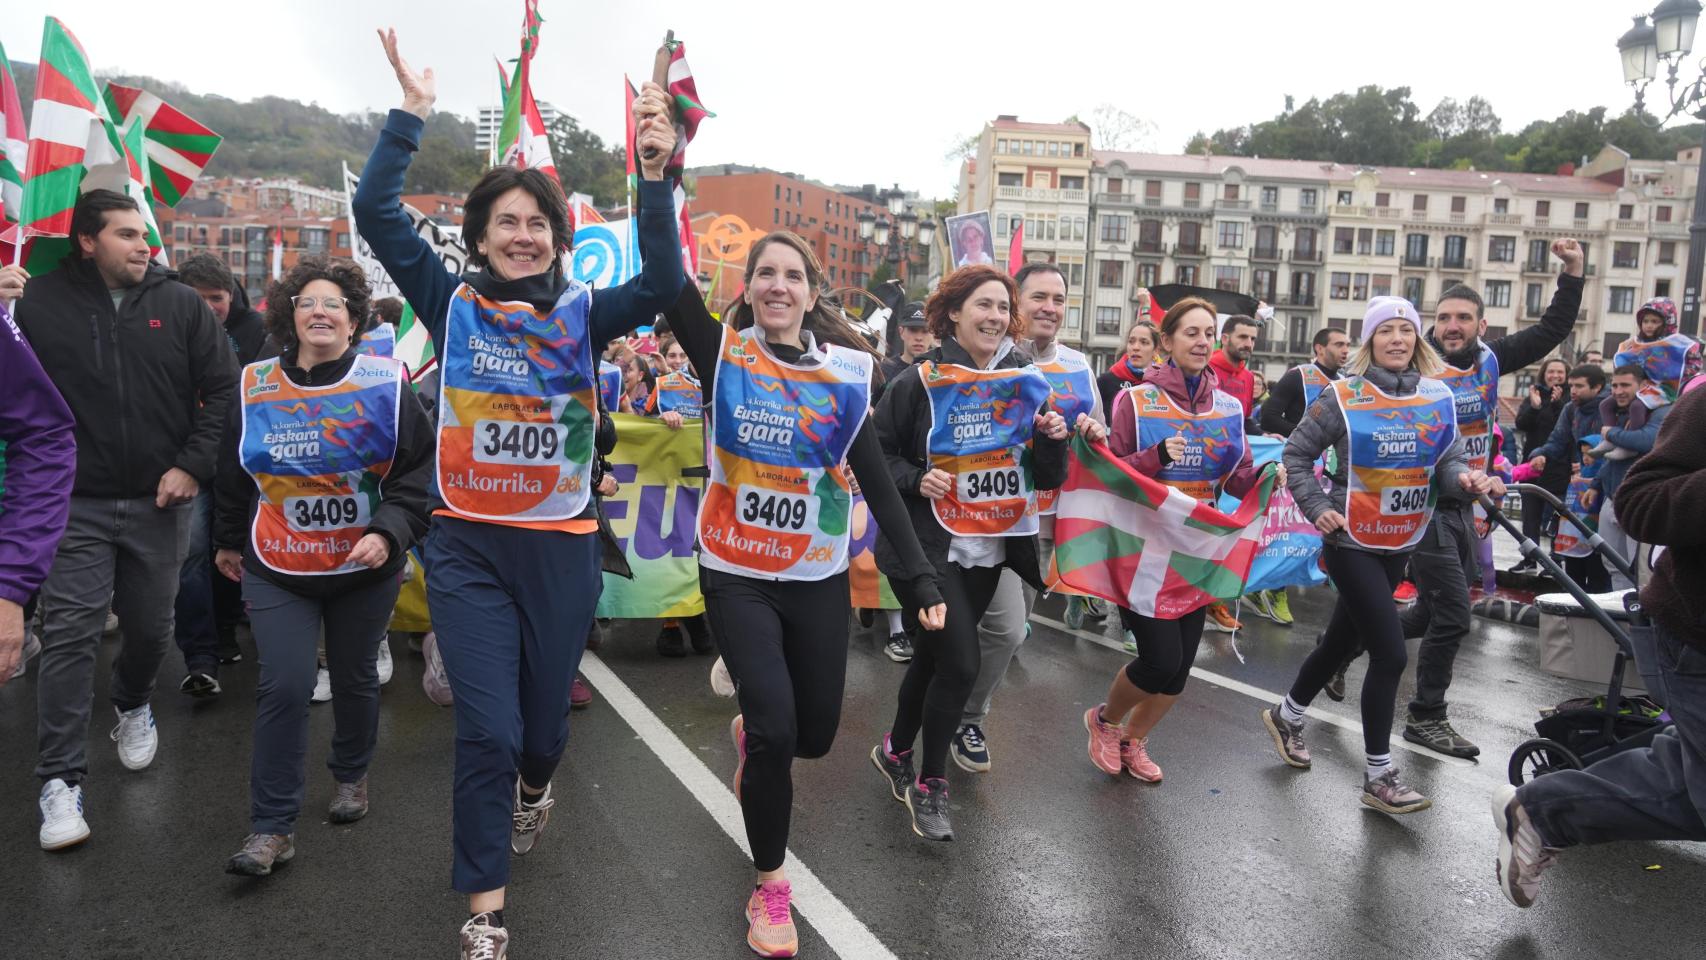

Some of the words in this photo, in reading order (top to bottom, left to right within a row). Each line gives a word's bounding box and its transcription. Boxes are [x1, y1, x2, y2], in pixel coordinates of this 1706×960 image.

[366, 369, 394, 378] eitb
[472, 352, 529, 375] gara
[733, 405, 795, 428] Euskara
[947, 411, 991, 425] Euskara
[263, 430, 319, 443] Euskara
[484, 422, 559, 459] 3409
[737, 422, 794, 446] gara
[953, 422, 992, 443] gara
[1372, 430, 1416, 441] Euskara
[269, 441, 320, 462] gara
[1377, 441, 1417, 458] gara
[447, 469, 543, 494] 24.korrika
[556, 473, 583, 494] aek
[756, 471, 792, 483] LABORAL
[967, 470, 1020, 499] 3409
[1390, 487, 1428, 512] 3409
[294, 498, 358, 527] 3409
[743, 491, 807, 530] 3409
[263, 535, 350, 554] 24.korrika
[703, 525, 793, 560] 24.korrika
[804, 545, 834, 562] aek
